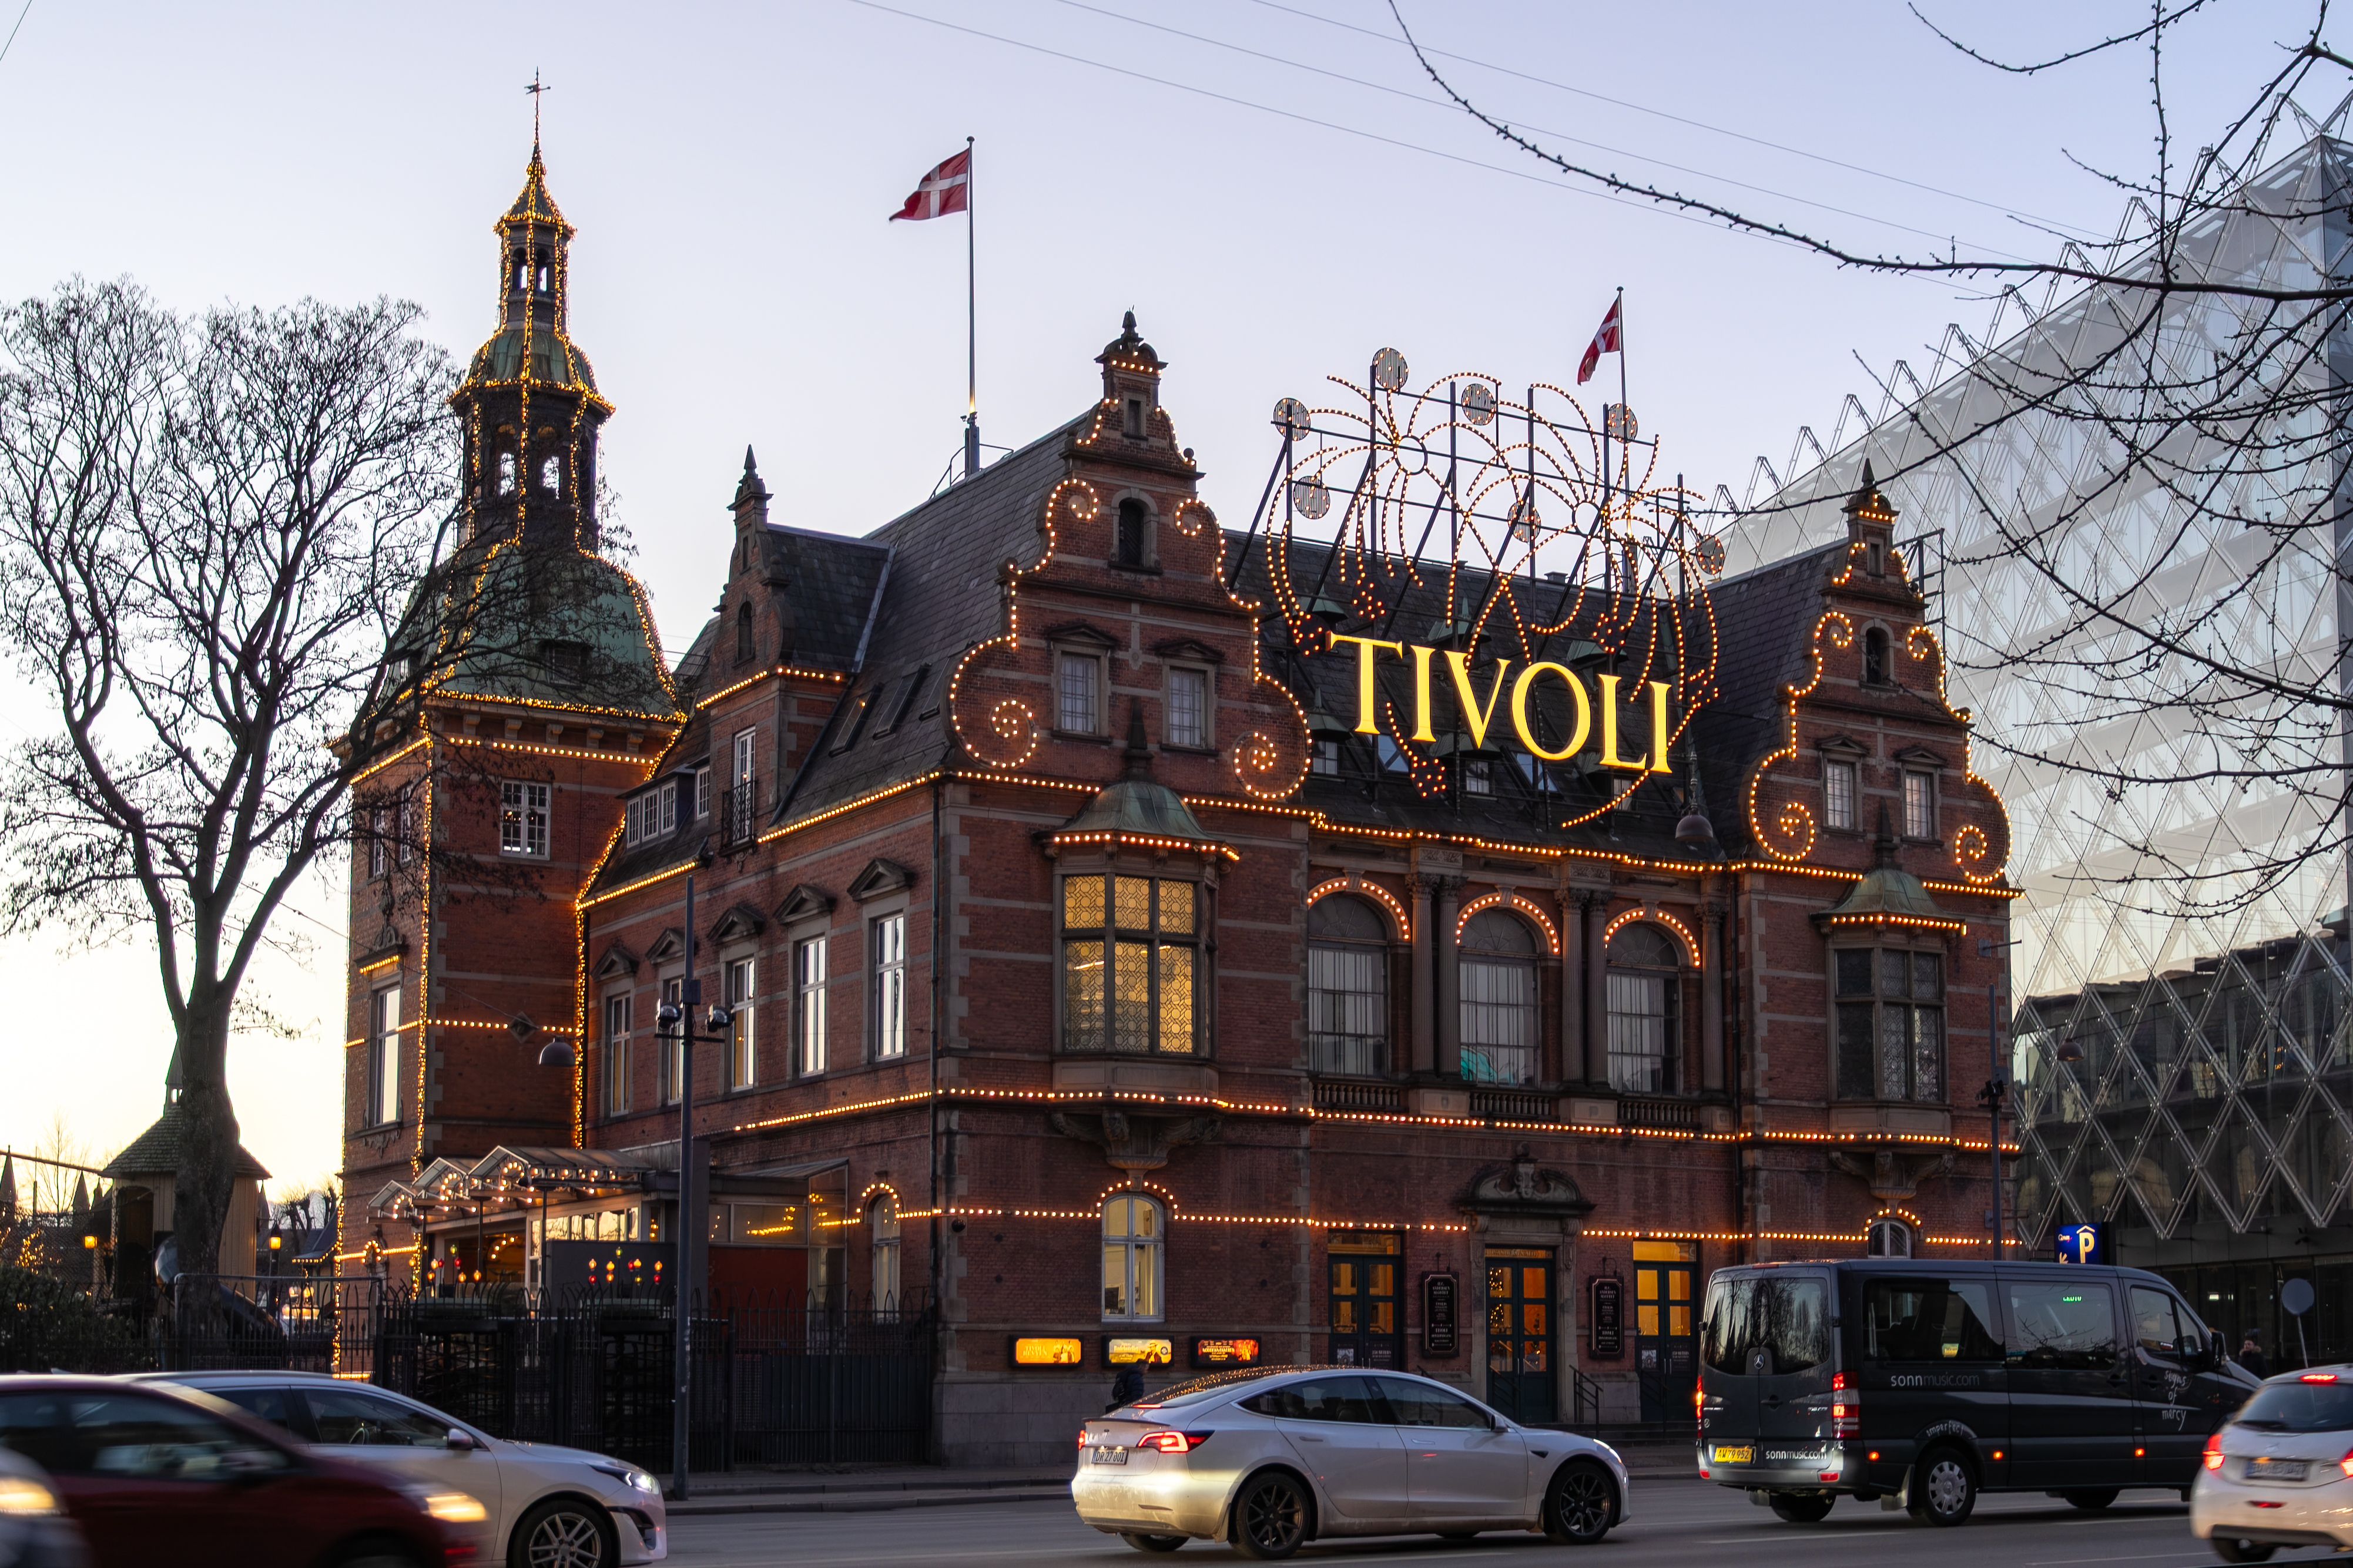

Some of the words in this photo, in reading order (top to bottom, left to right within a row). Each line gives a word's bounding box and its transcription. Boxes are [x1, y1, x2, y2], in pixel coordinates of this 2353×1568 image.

[1325, 630, 1672, 774] TIVOLI
[2079, 1232, 2095, 1264] P
[1891, 1372, 1980, 1387] sonnmusic.com
[2164, 1370, 2187, 1389] signs
[2168, 1386, 2177, 1406] of
[2162, 1409, 2187, 1432] mercy
[1095, 1451, 1105, 1462] DR
[1105, 1451, 1114, 1462] 27
[1718, 1449, 1727, 1458] AW
[1728, 1449, 1736, 1458] 79
[1737, 1449, 1749, 1459] 952
[1766, 1449, 1827, 1460] sonnmusic.com
